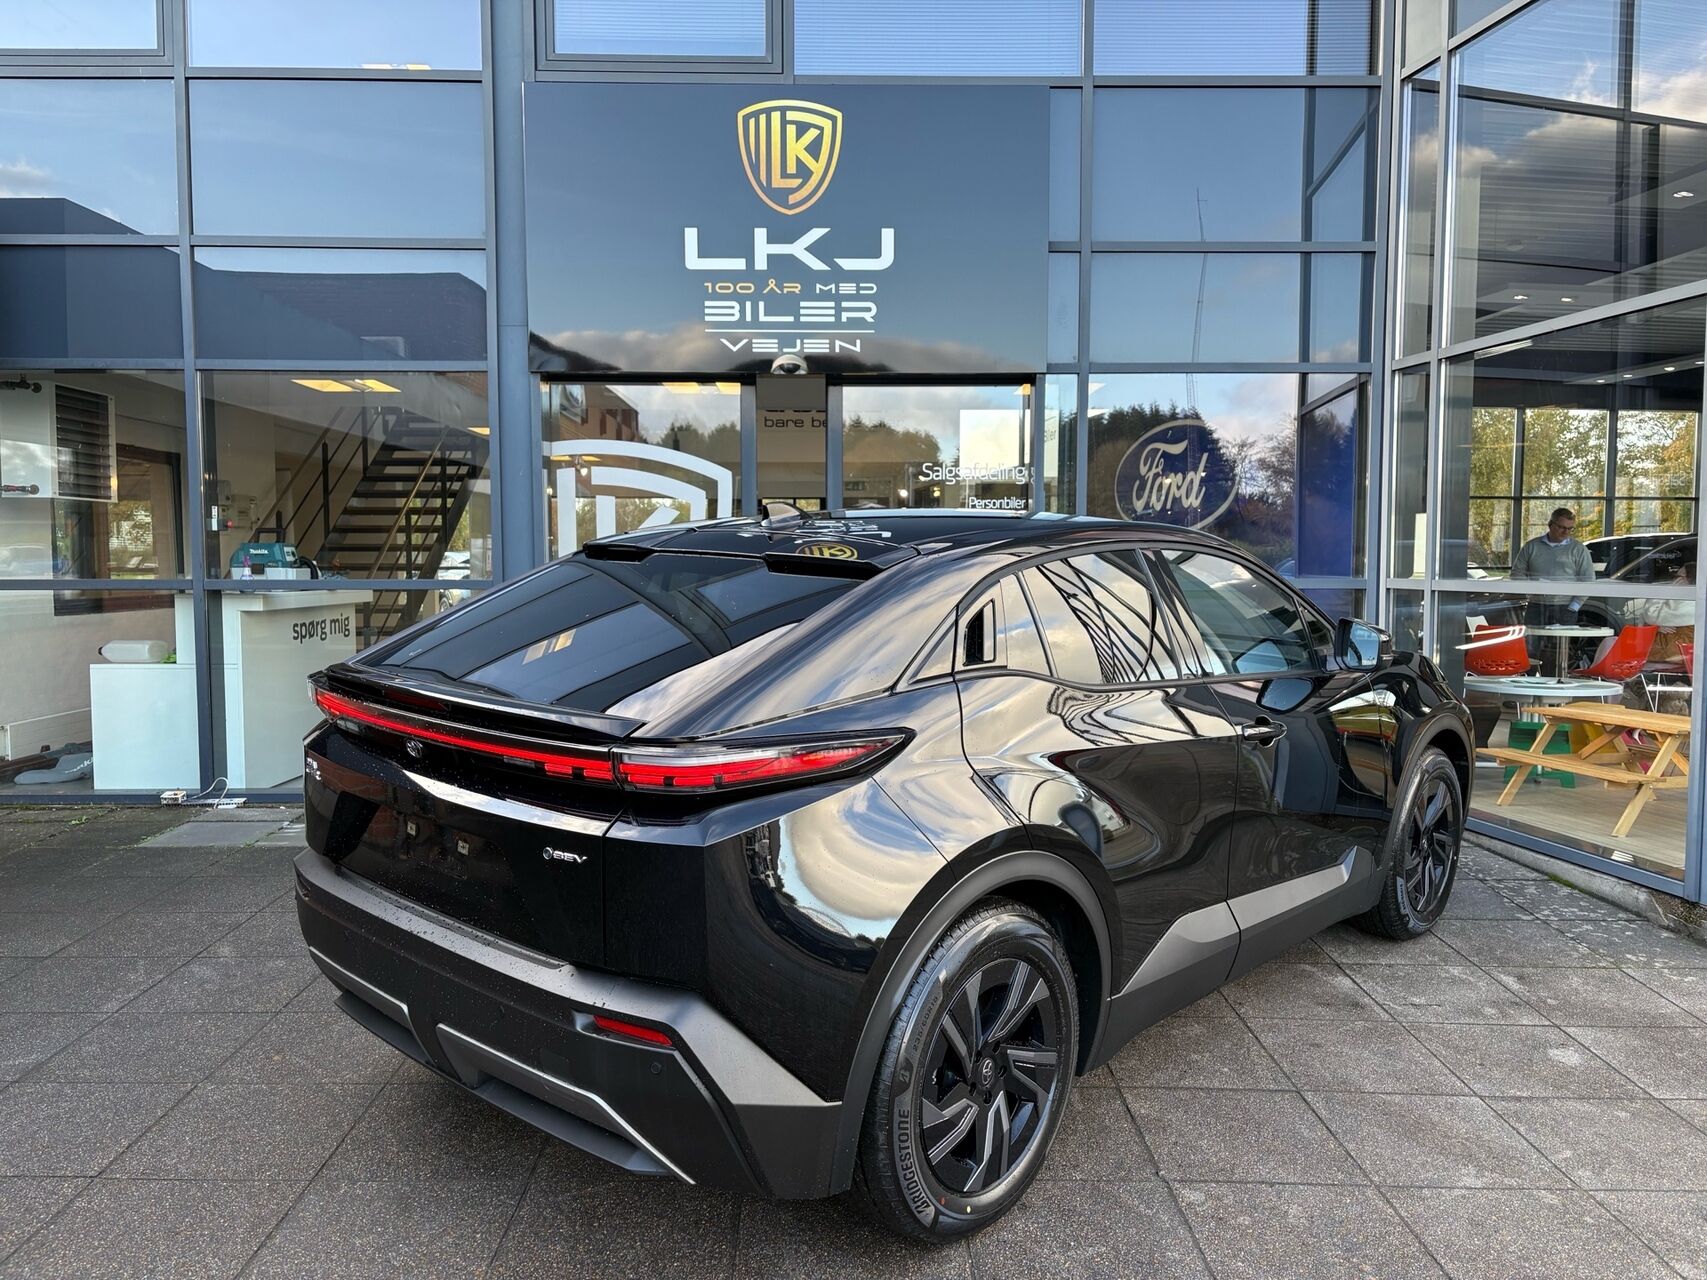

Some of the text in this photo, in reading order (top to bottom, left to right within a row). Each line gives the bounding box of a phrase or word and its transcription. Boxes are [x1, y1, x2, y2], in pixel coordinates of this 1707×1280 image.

[684, 227, 895, 270] LKJ
[704, 278, 878, 294] 100 ÅR MED
[704, 300, 878, 323] BILER
[719, 338, 862, 353] VEJEN
[764, 416, 804, 428] bare
[922, 462, 1027, 485] Salgsafdeling
[1133, 439, 1208, 513] Ford
[968, 496, 1026, 509] Personbiler
[292, 612, 351, 645] spørg mig
[553, 850, 588, 863] BEV
